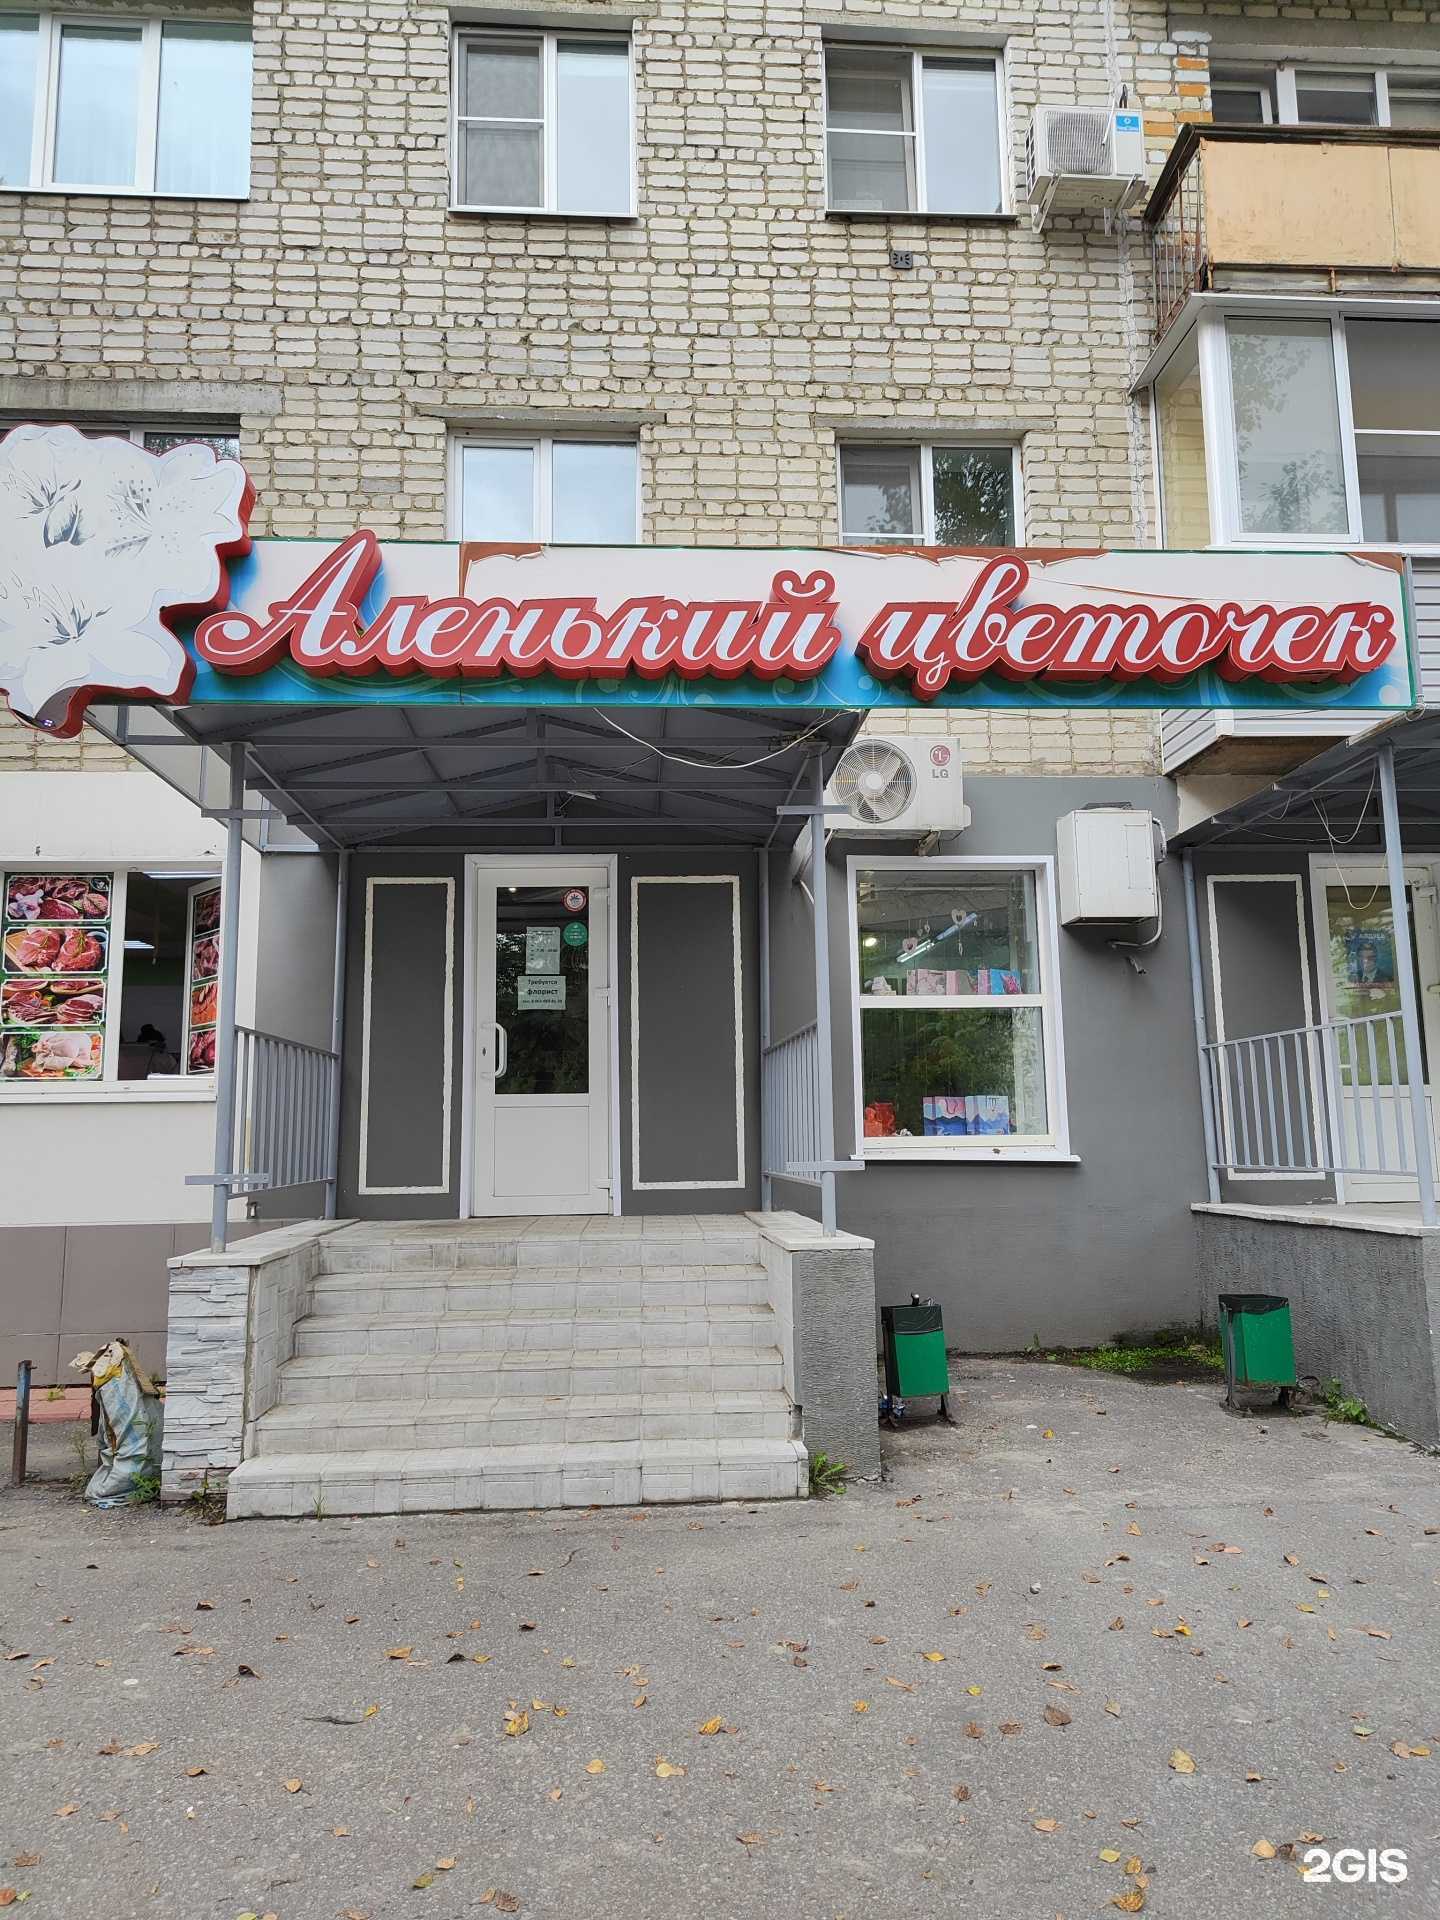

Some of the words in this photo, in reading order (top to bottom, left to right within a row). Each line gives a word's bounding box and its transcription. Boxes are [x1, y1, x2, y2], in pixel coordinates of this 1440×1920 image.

[202, 541, 837, 660] Аленький
[868, 562, 1390, 686] цветочек
[932, 769, 949, 778] LG
